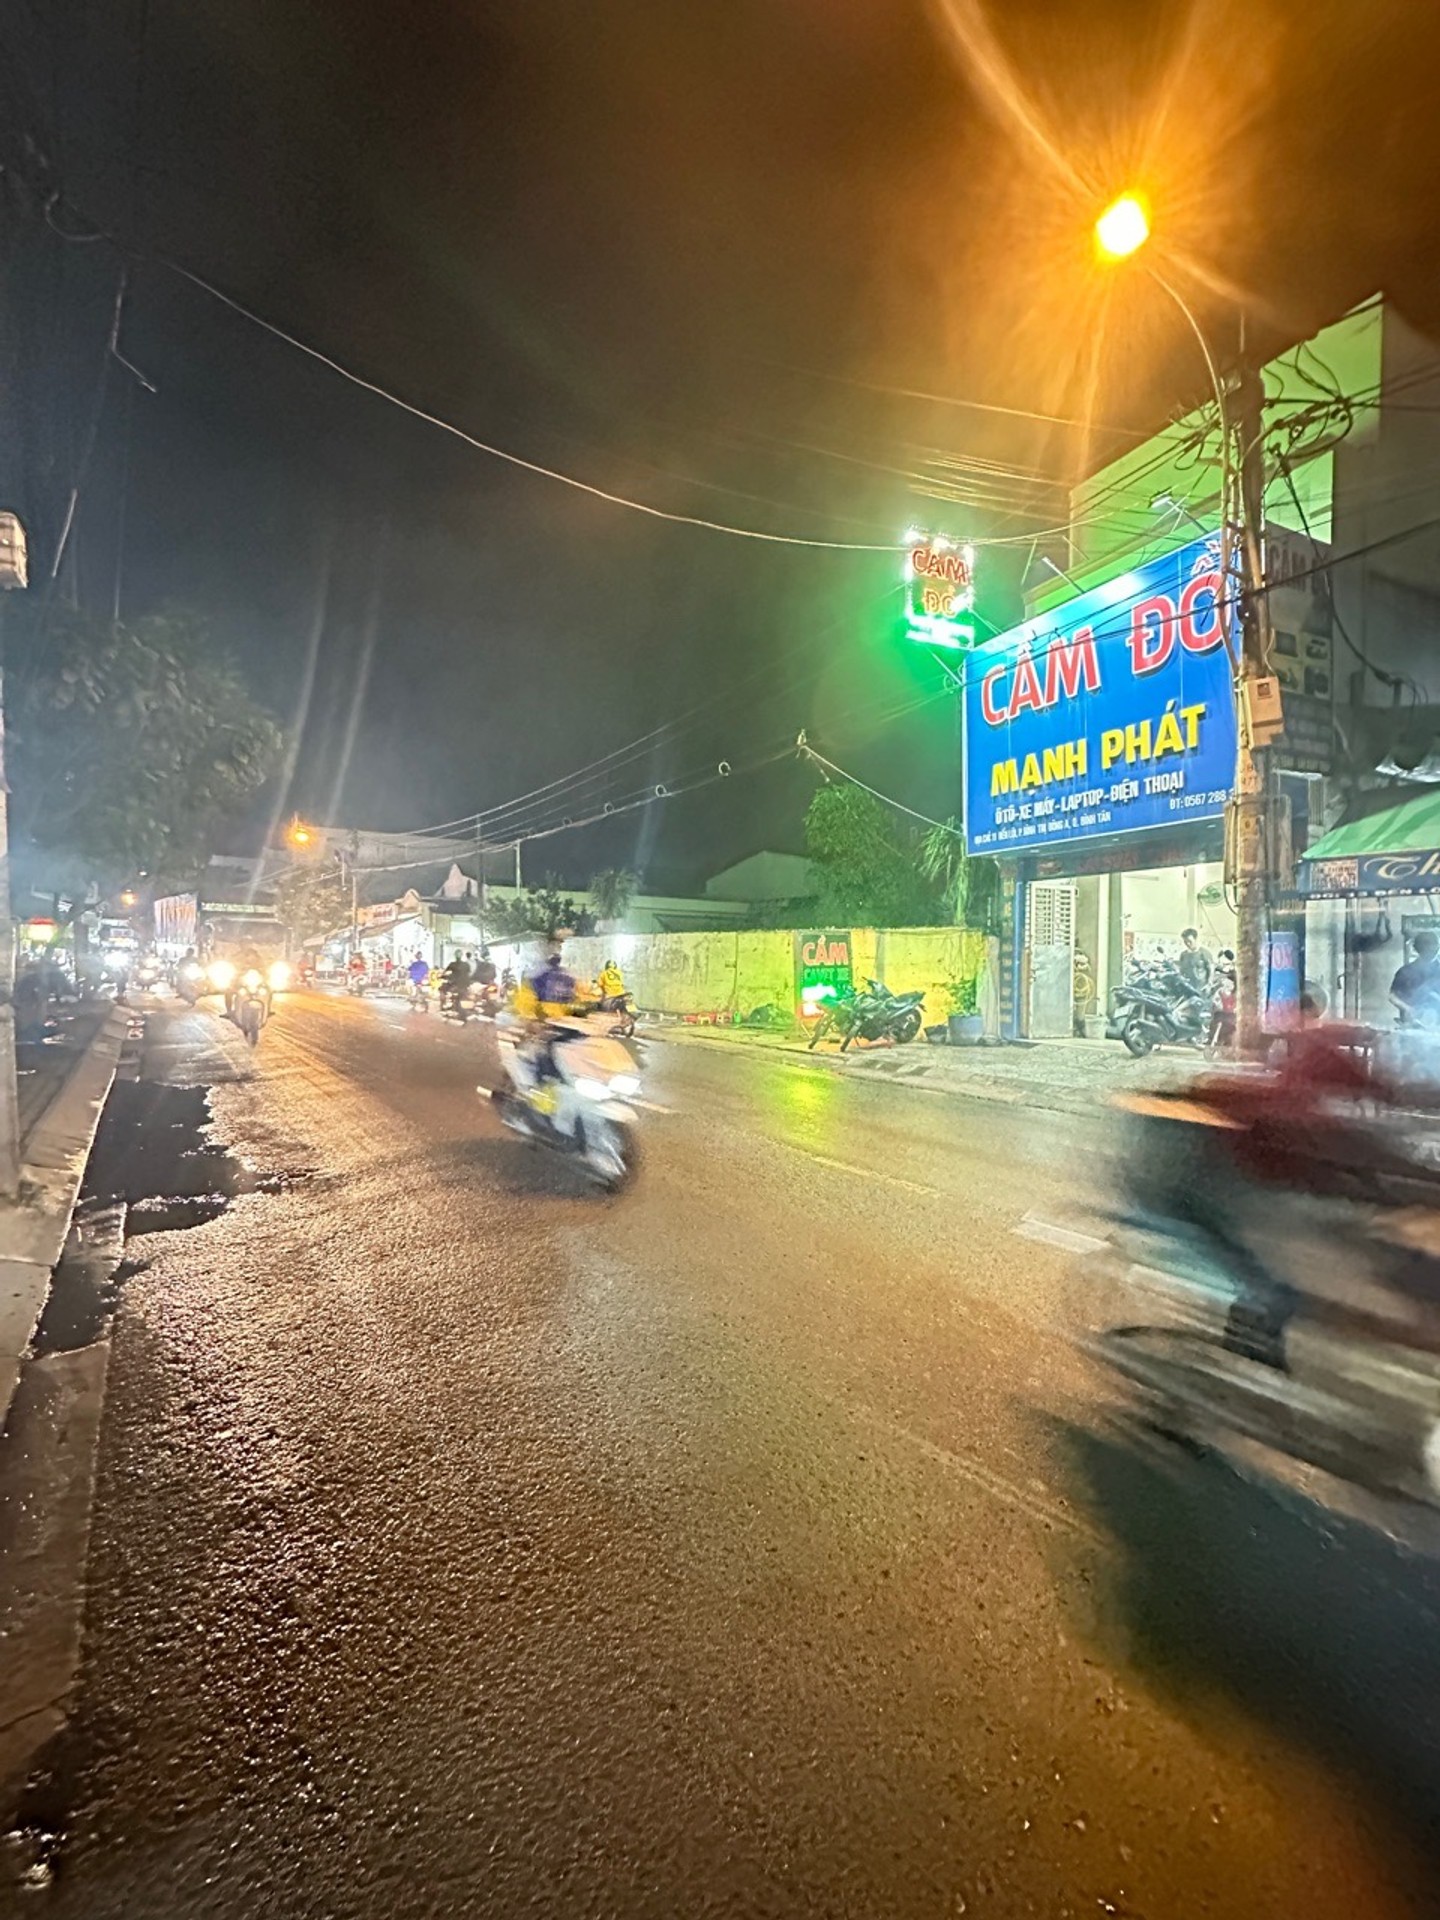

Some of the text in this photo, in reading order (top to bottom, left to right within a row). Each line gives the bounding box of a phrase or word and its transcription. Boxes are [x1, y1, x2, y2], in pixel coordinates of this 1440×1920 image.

[990, 699, 1206, 798] MẠNH PHÁT
[1143, 770, 1184, 795] THOẠI
